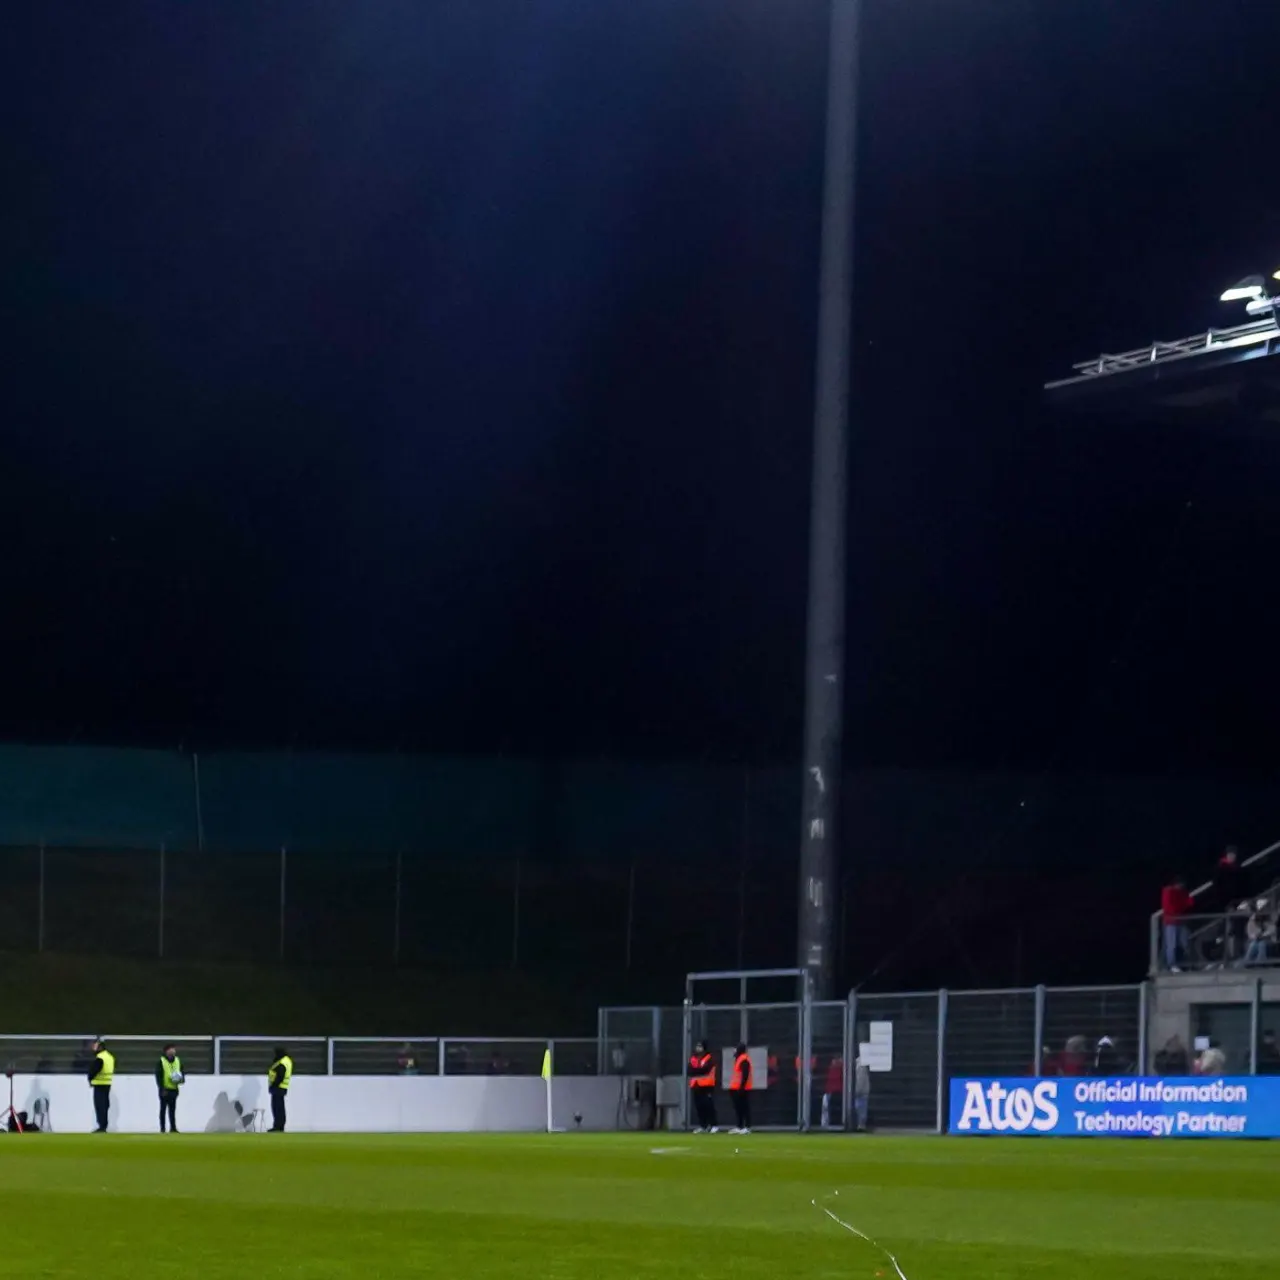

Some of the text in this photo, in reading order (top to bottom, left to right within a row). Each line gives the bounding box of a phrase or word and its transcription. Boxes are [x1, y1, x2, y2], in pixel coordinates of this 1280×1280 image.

[1075, 1079, 1247, 1102] Official Information
[1075, 1110, 1247, 1136] Technology Partner
